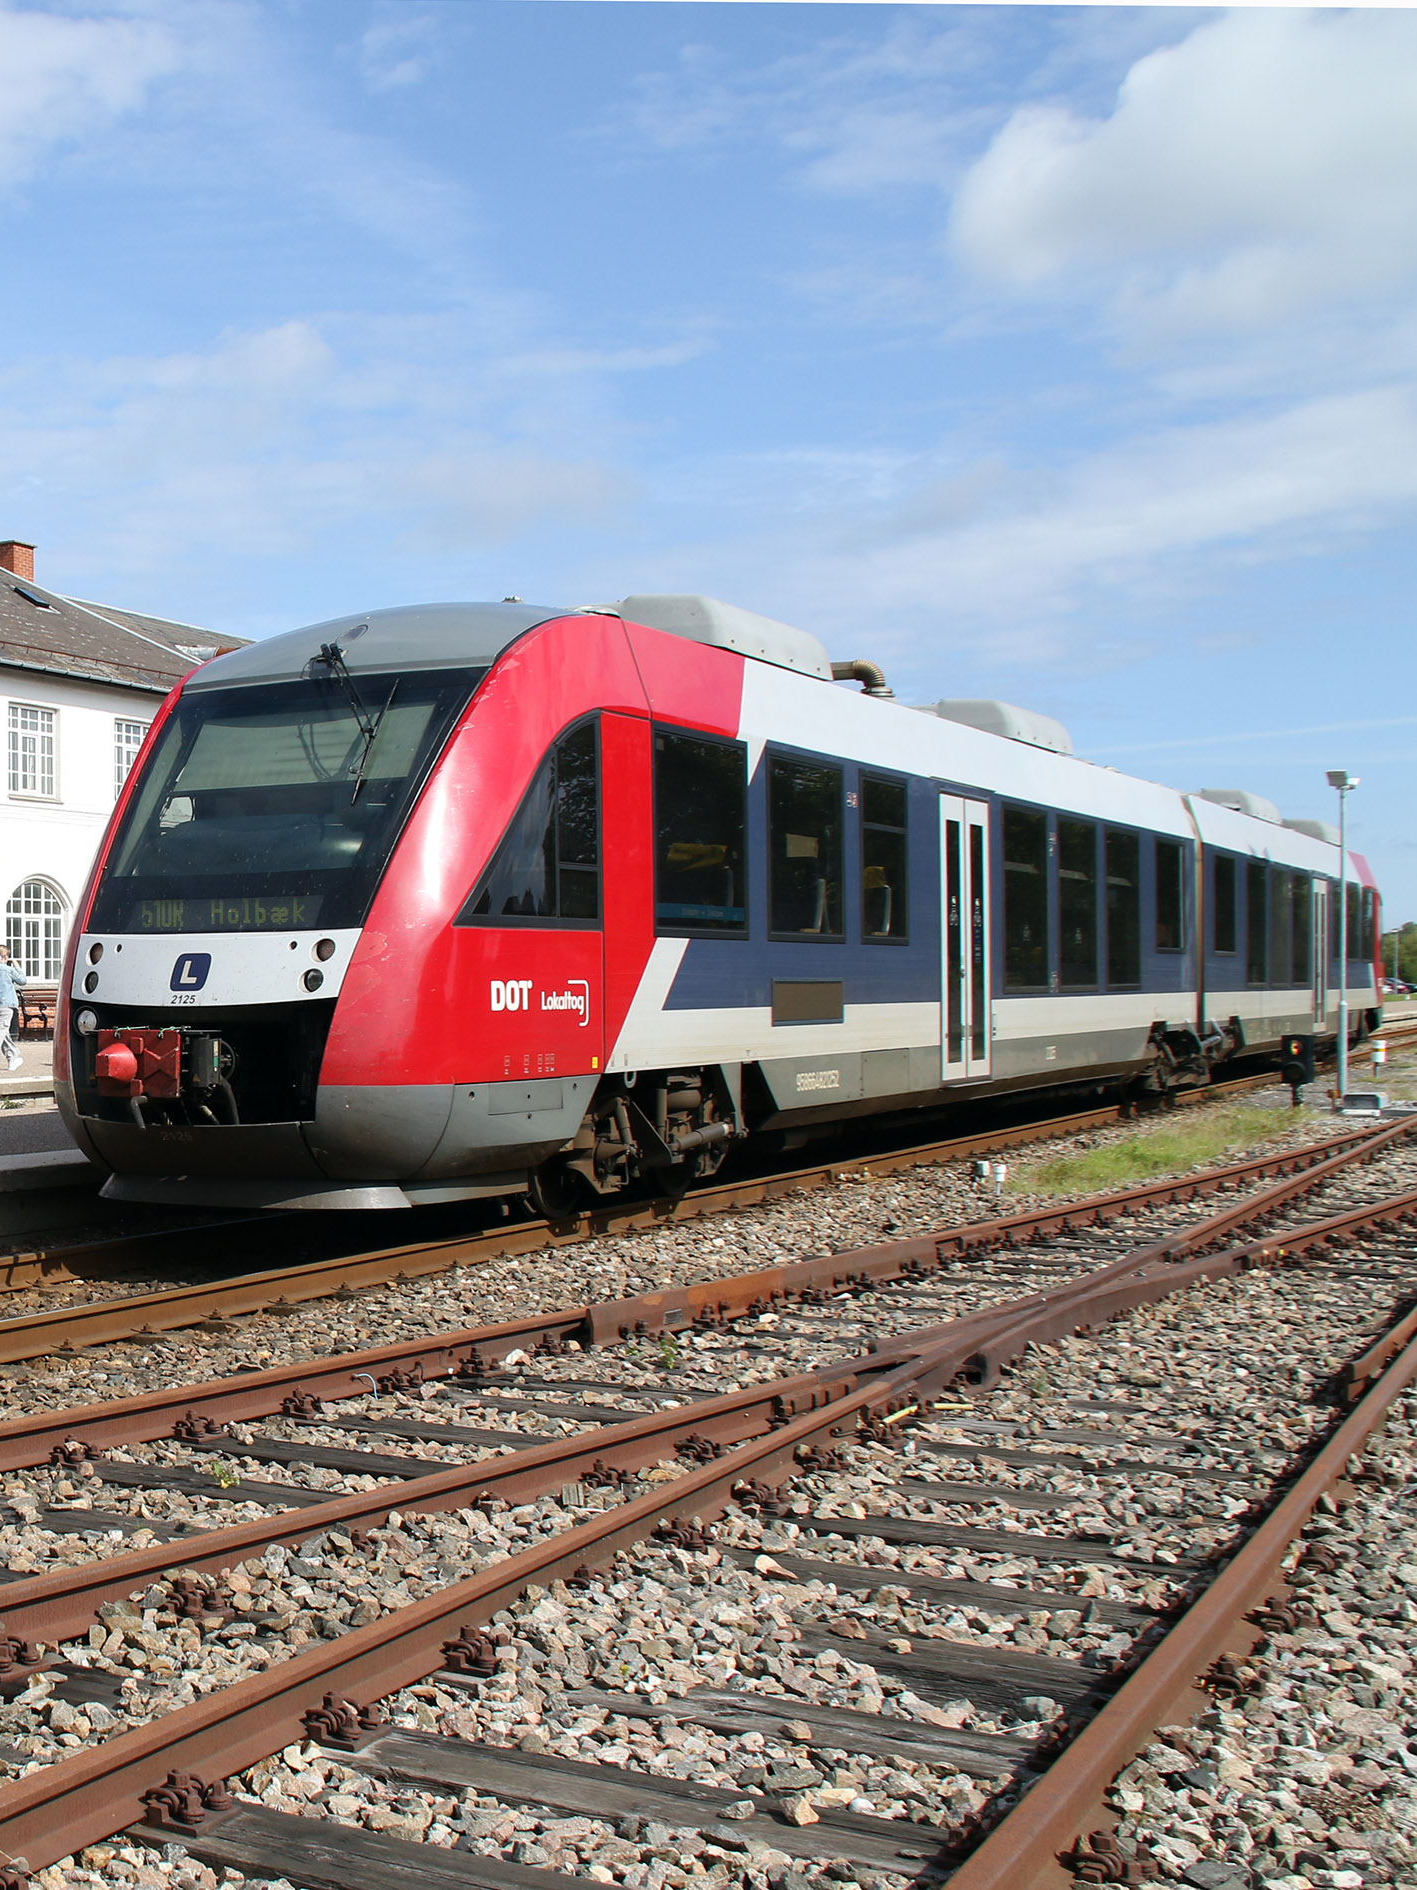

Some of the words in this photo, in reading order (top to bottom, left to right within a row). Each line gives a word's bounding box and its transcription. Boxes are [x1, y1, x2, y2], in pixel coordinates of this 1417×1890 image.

[210, 898, 305, 925] Holbæk
[180, 960, 198, 984] L
[170, 994, 196, 1004] 2125
[490, 980, 533, 1011] DOT
[541, 991, 586, 1015] Lokaltog
